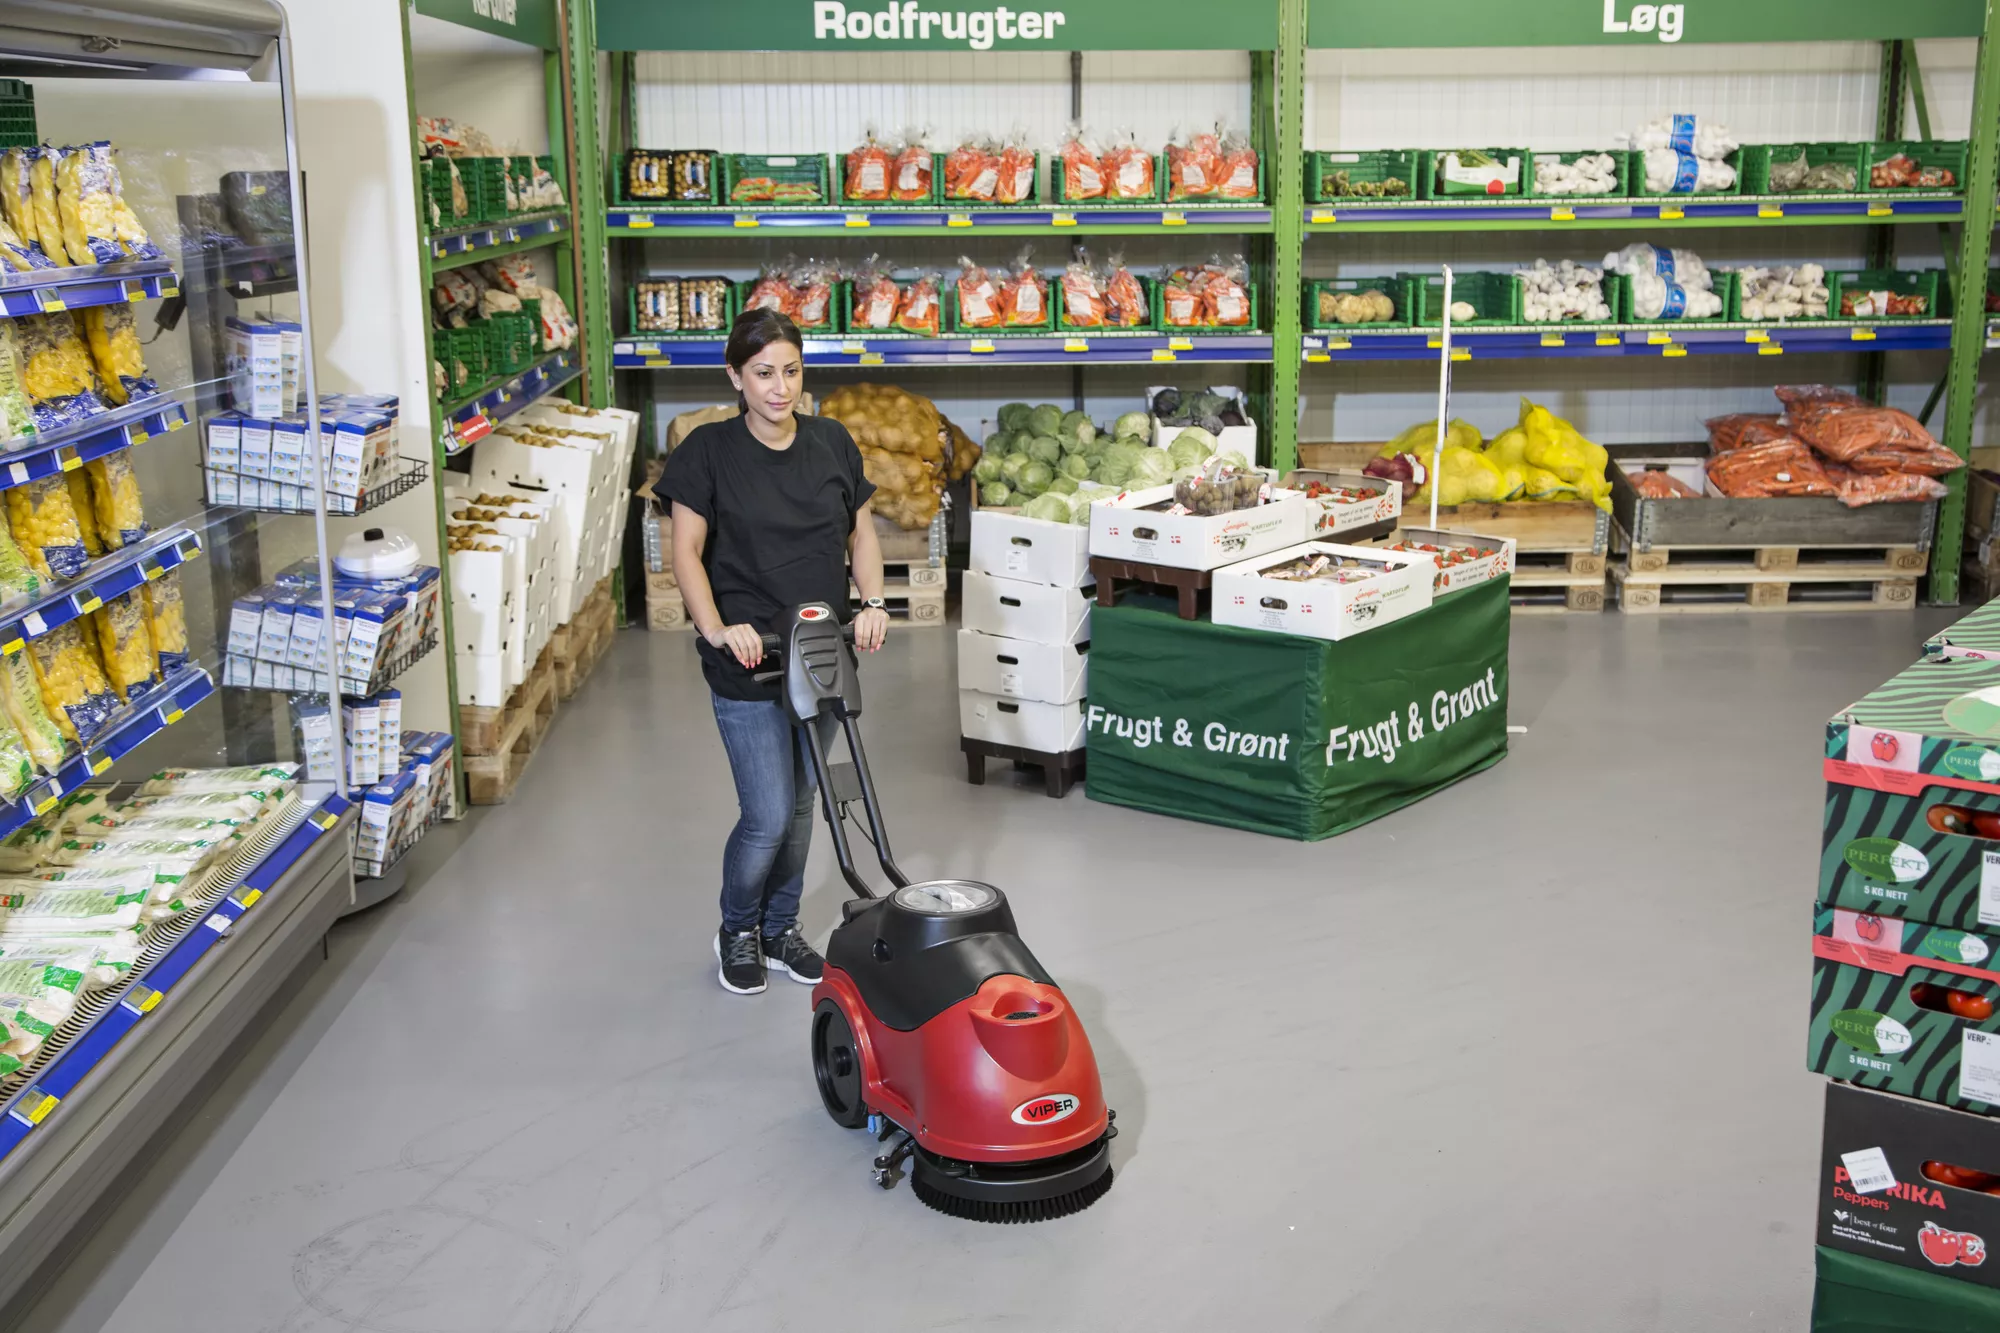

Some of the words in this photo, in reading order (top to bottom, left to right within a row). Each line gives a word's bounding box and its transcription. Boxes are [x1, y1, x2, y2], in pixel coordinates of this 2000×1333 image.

[813, 1, 1066, 50] Rodfrugter
[1603, 0, 1684, 42] Løg
[1325, 710, 1402, 767] Frugt
[1407, 701, 1424, 742] &
[1431, 666, 1499, 732] Grønt
[1087, 704, 1163, 748] Frugt
[1172, 718, 1193, 747] &
[1203, 721, 1290, 761] Grønt
[1848, 848, 1927, 872] PERFEKT
[1863, 885, 1870, 895] 5
[1871, 886, 1884, 897] KG
[1885, 888, 1909, 901] NETT
[1833, 1019, 1909, 1045] PERFEKT
[1849, 1054, 1855, 1064] 5
[1856, 1056, 1869, 1067] KG
[1870, 1059, 1892, 1072] NETT
[1027, 1098, 1074, 1118] VIPER
[1833, 1186, 1890, 1211] Peppers
[1834, 1165, 1947, 1210] PRIKA
[1853, 1215, 1871, 1227] best
[1879, 1222, 1898, 1234] four
